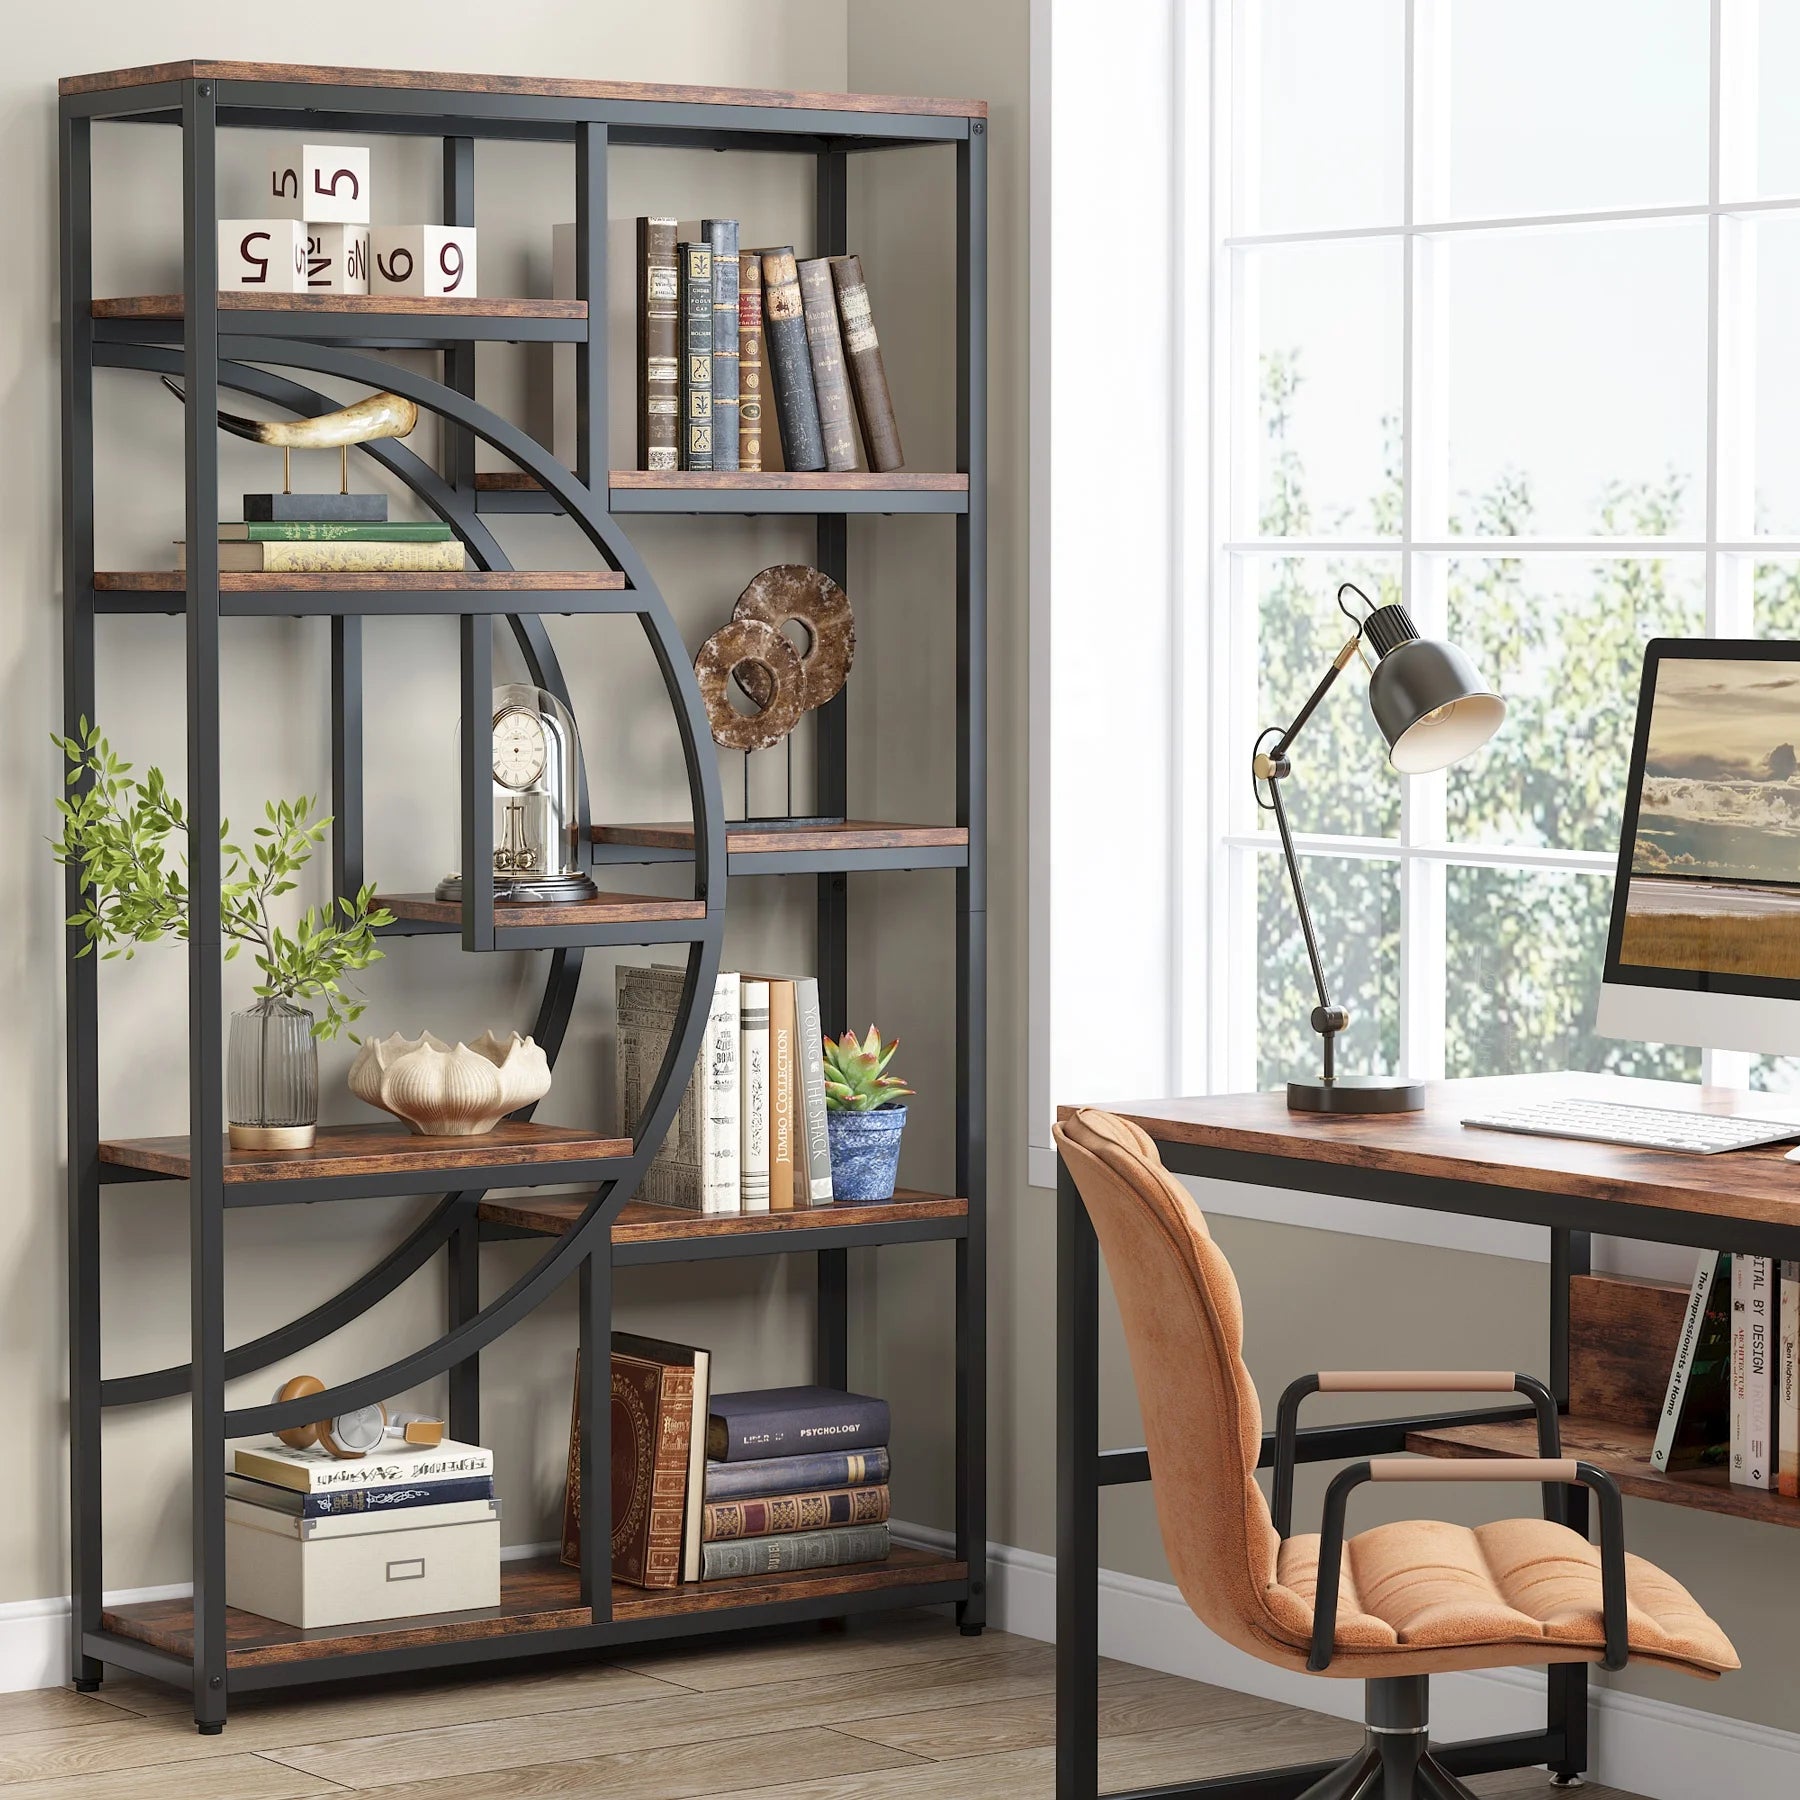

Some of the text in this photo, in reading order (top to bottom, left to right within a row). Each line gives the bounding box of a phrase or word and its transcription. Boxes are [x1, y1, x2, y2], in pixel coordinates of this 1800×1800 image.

[272, 168, 298, 199] 5
[314, 168, 360, 201] 5
[240, 231, 272, 284] 5
[776, 1029, 791, 1164] JUMBO COLLECTION
[804, 1005, 828, 1162] YOUNG THE SHACK
[1752, 1299, 1765, 1317] BY
[1666, 1271, 1709, 1417] The Impressionists at Home
[1737, 1327, 1745, 1400] ARCHITECTURE
[1752, 1324, 1764, 1376] DESIGN
[1786, 1342, 1794, 1359] Ben
[800, 1423, 861, 1438] PSYCHOLOGY
